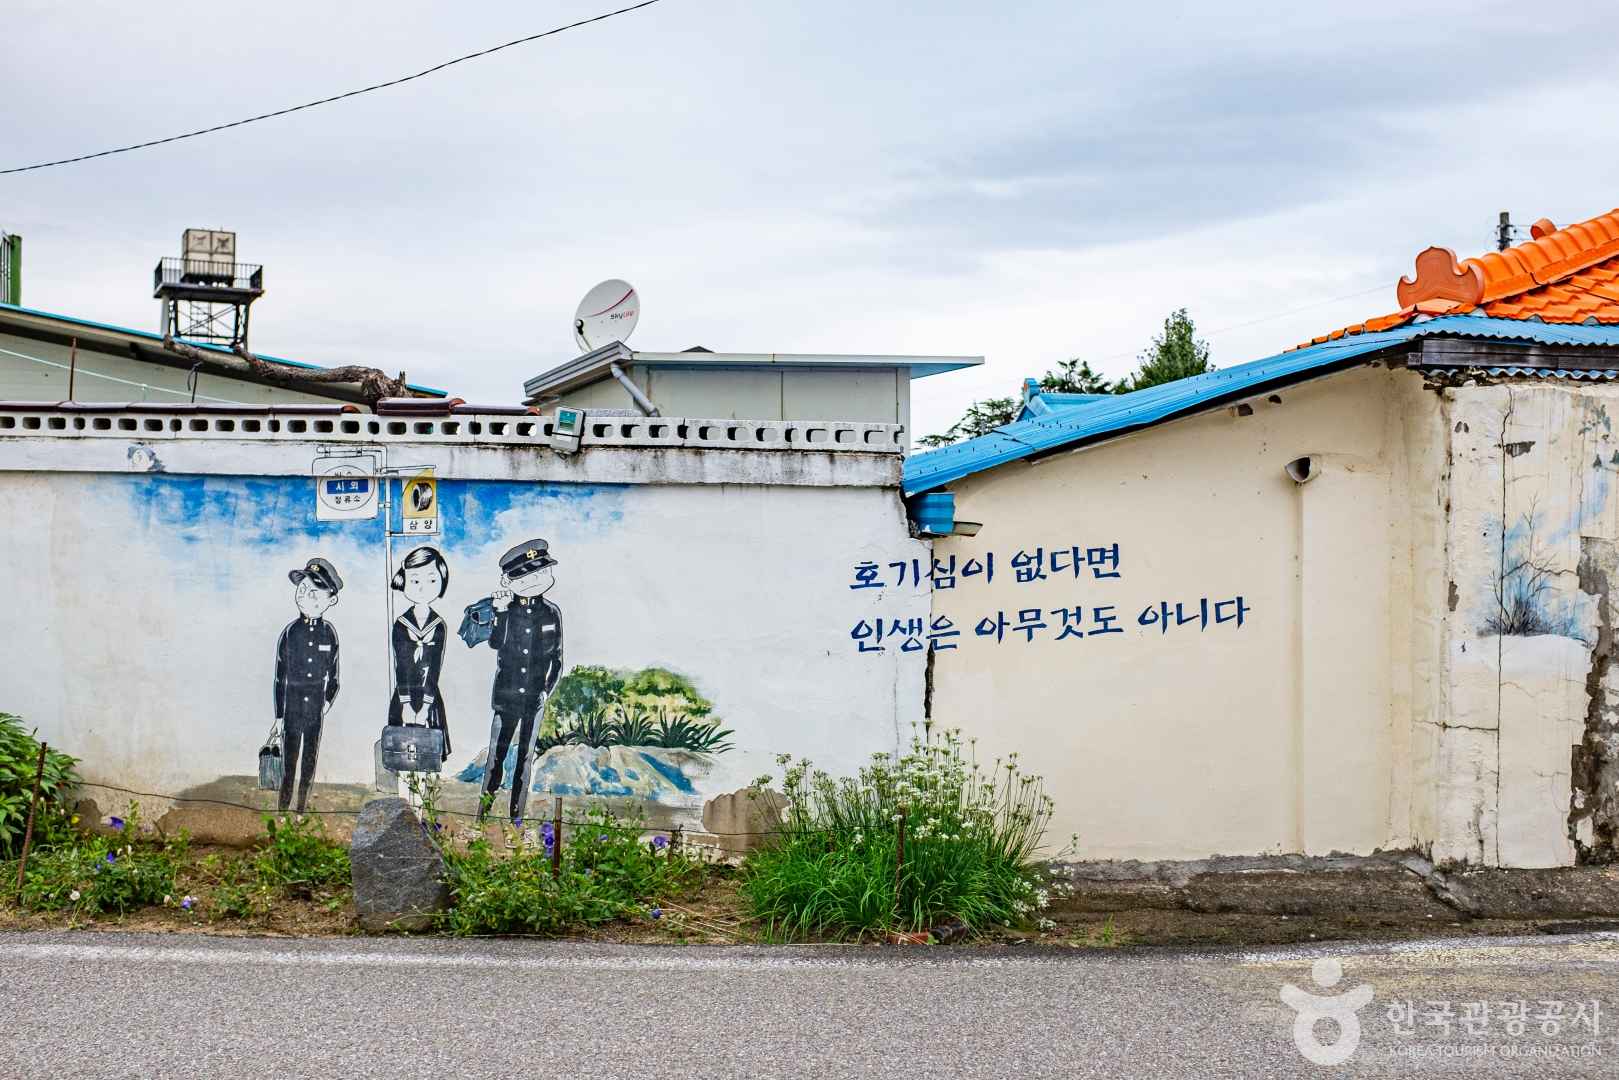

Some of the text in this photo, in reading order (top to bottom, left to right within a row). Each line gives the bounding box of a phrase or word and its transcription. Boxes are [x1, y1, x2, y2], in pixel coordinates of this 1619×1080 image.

[335, 495, 361, 504] 정류소
[409, 520, 433, 530] 삼양
[849, 543, 1122, 590] 호기심이 없다면
[850, 596, 1250, 653] 인생은 아무것도 아니다
